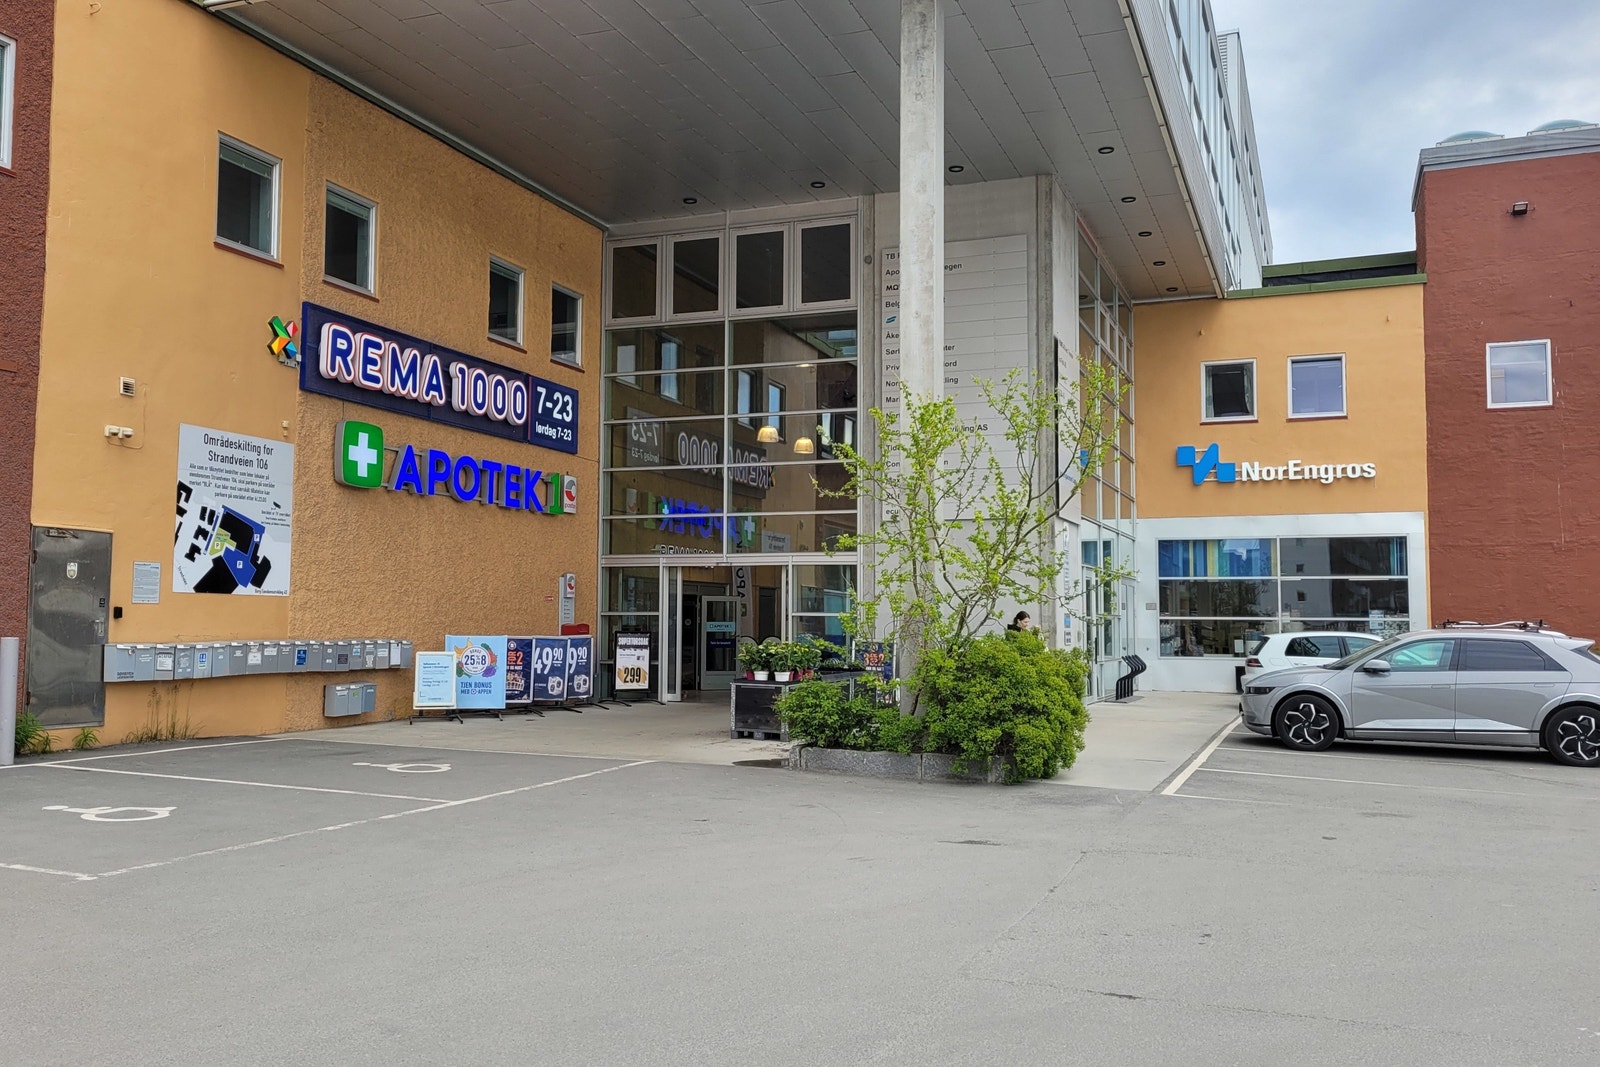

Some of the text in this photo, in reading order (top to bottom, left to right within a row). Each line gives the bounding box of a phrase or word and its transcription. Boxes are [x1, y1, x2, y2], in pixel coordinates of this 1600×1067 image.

[885, 263, 962, 278] Apo egen
[886, 331, 900, 340] Åke
[320, 322, 528, 427] REMA 1000
[536, 386, 573, 422] 7-23
[536, 421, 572, 441] lørdag 7-23
[203, 433, 274, 456] Områdeskilting for
[208, 450, 268, 470] Strandveien 106
[388, 444, 565, 515] APOTEK 1
[1241, 459, 1377, 484] NorEngros
[464, 655, 475, 666] 25
[481, 655, 487, 666] 8
[508, 651, 523, 665] FOR 2
[534, 647, 563, 674] 49 90
[569, 646, 587, 674] 9 90
[624, 667, 641, 684] 299
